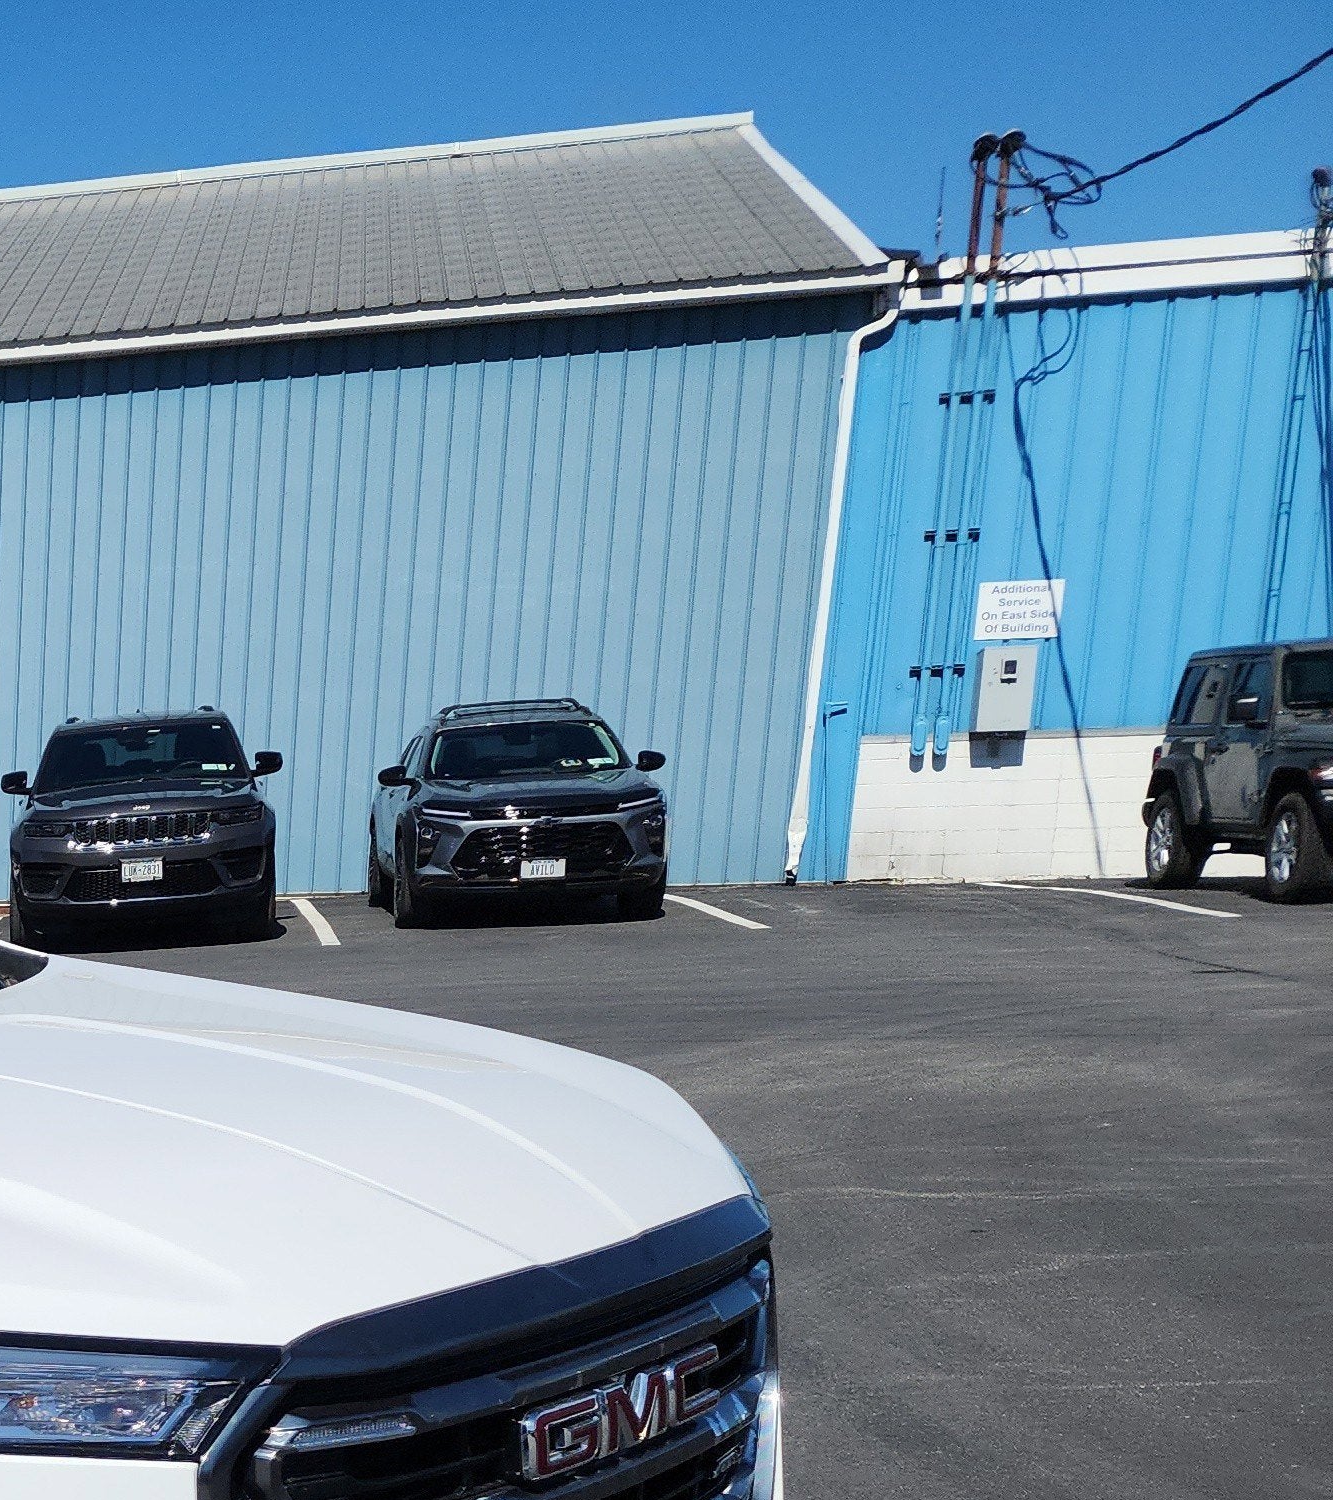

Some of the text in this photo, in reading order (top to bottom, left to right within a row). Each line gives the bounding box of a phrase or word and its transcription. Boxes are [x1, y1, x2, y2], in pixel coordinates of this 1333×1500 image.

[998, 598, 1042, 607] Service
[981, 609, 1056, 621] On East Side
[984, 623, 1049, 634] Of Building
[520, 1343, 721, 1482] GMC
